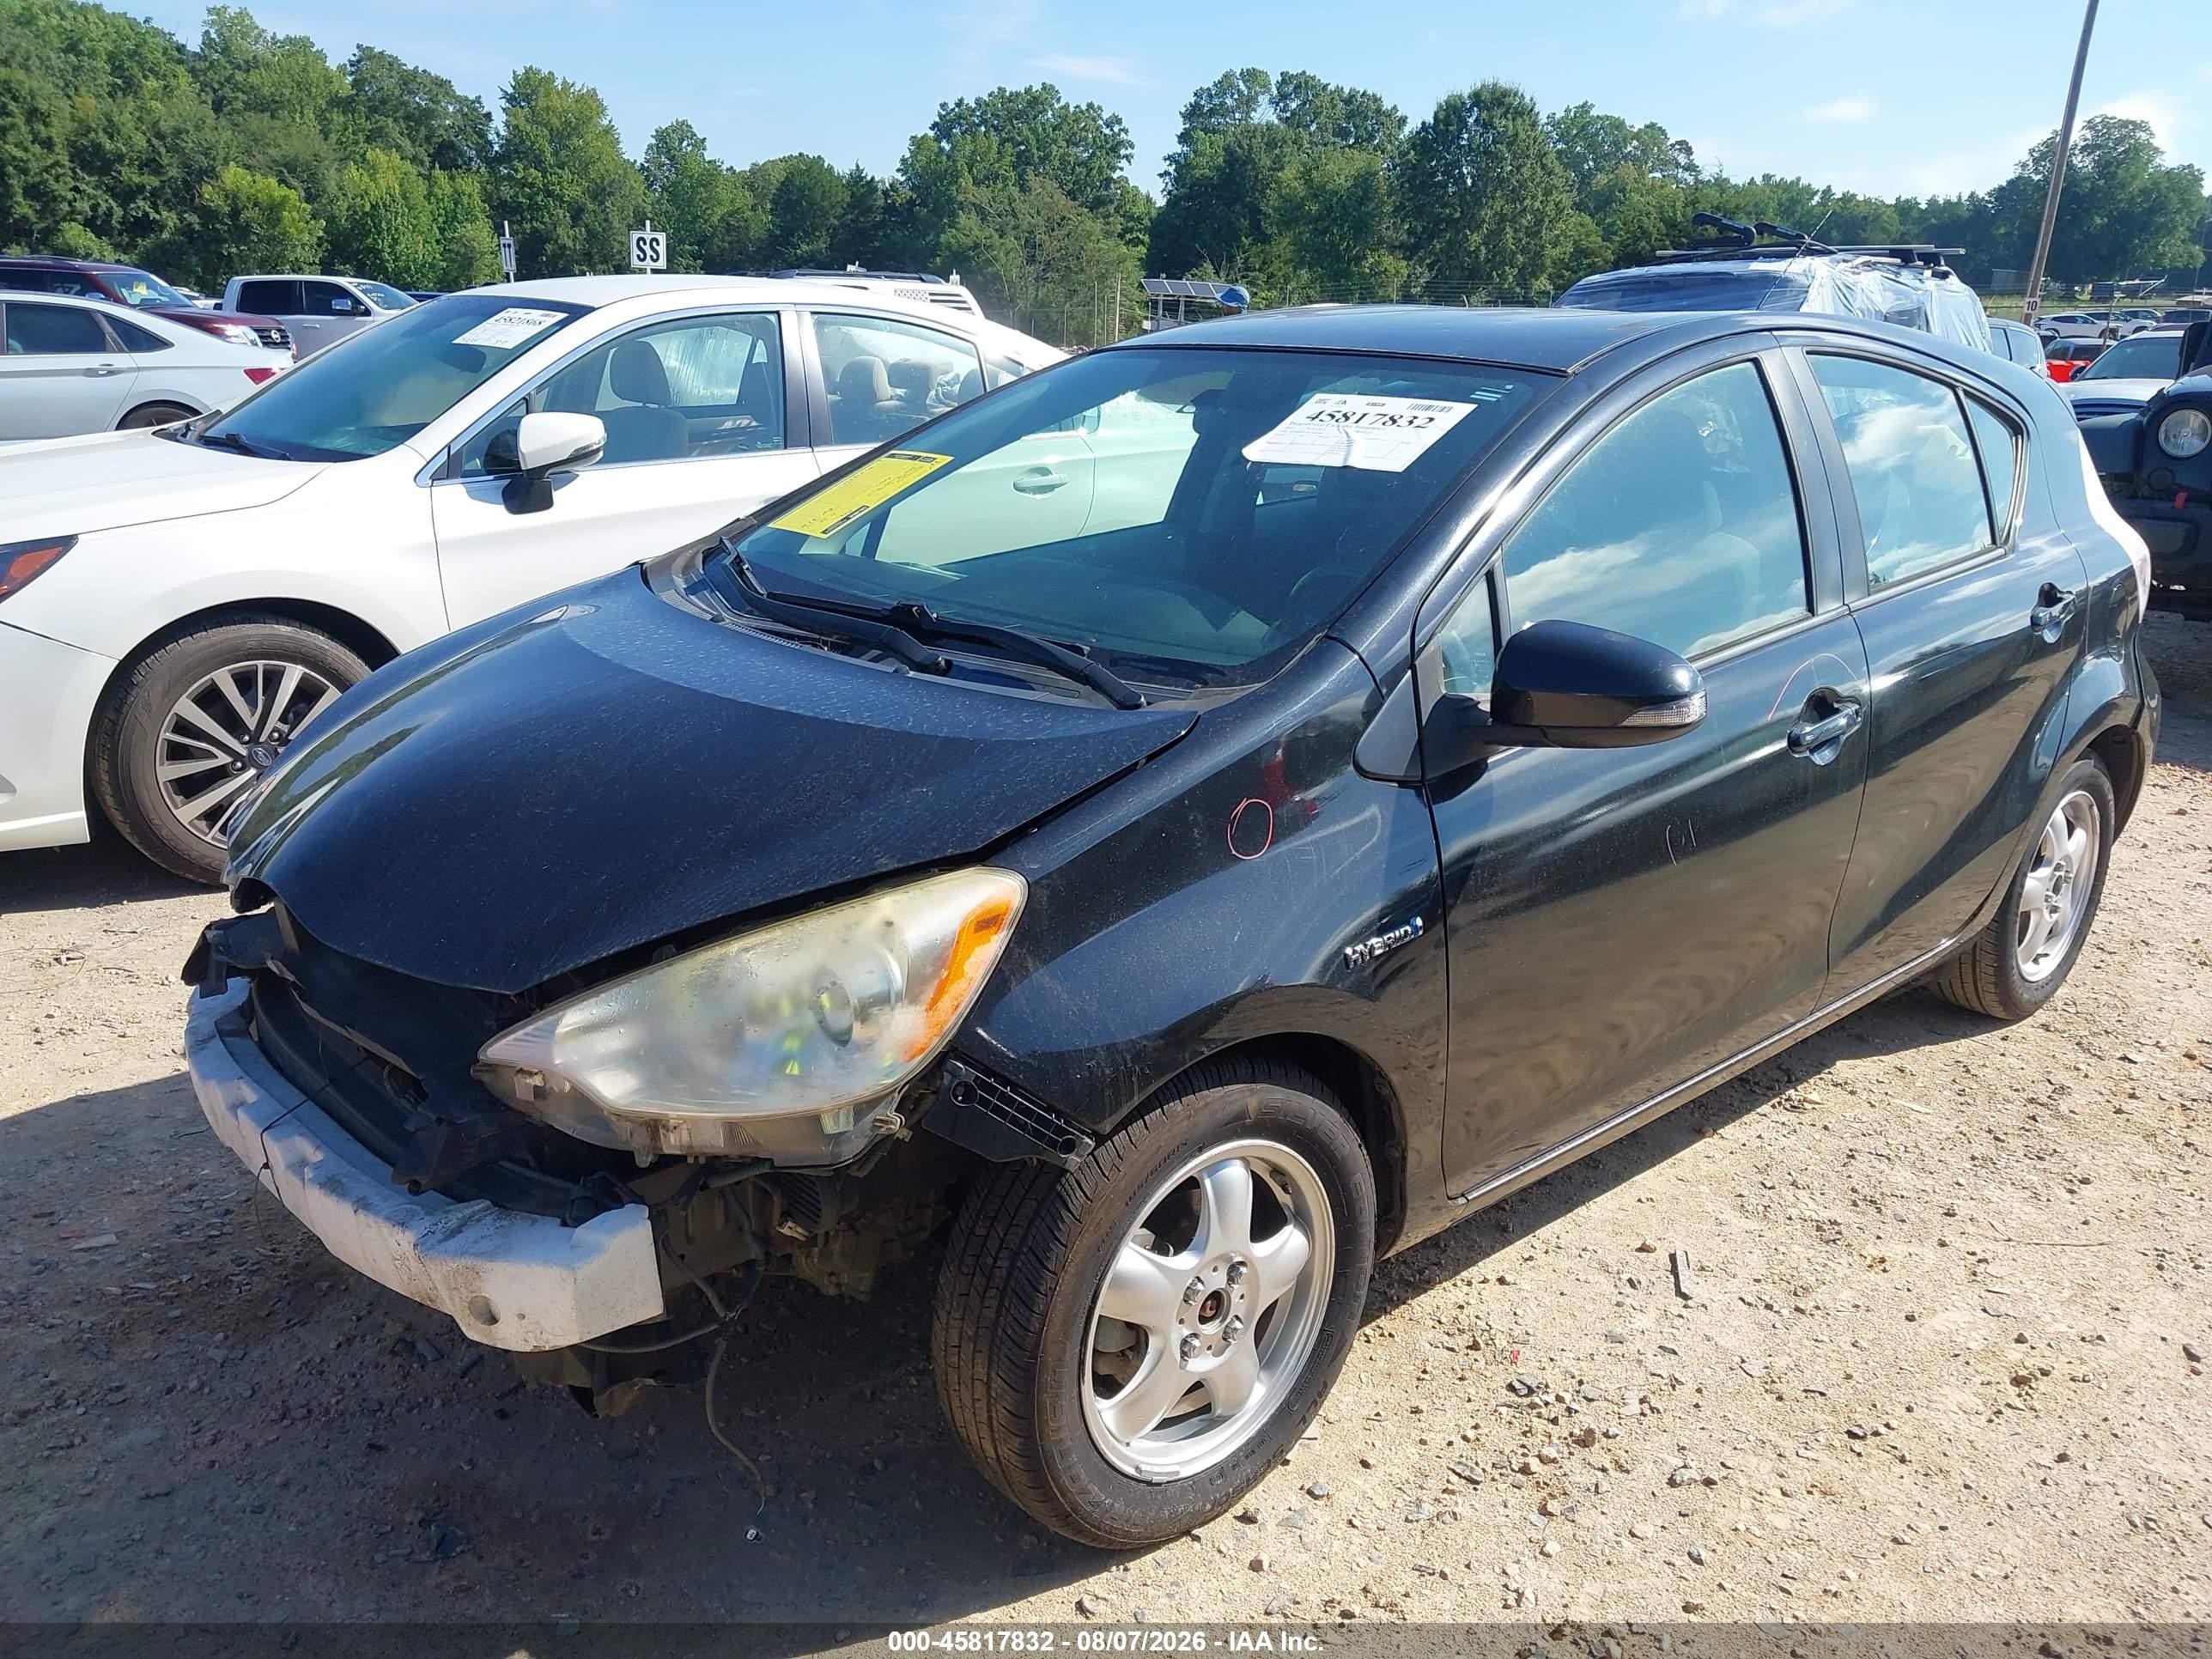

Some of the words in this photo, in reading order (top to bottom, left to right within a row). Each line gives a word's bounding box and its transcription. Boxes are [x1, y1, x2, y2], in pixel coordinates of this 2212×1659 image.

[635, 236, 660, 263] SS
[2027, 301, 2038, 312] 10
[1306, 410, 1435, 428] 45817832
[1344, 925, 1413, 971] HYBRID
[1256, 1095, 1352, 1164] SILVER
